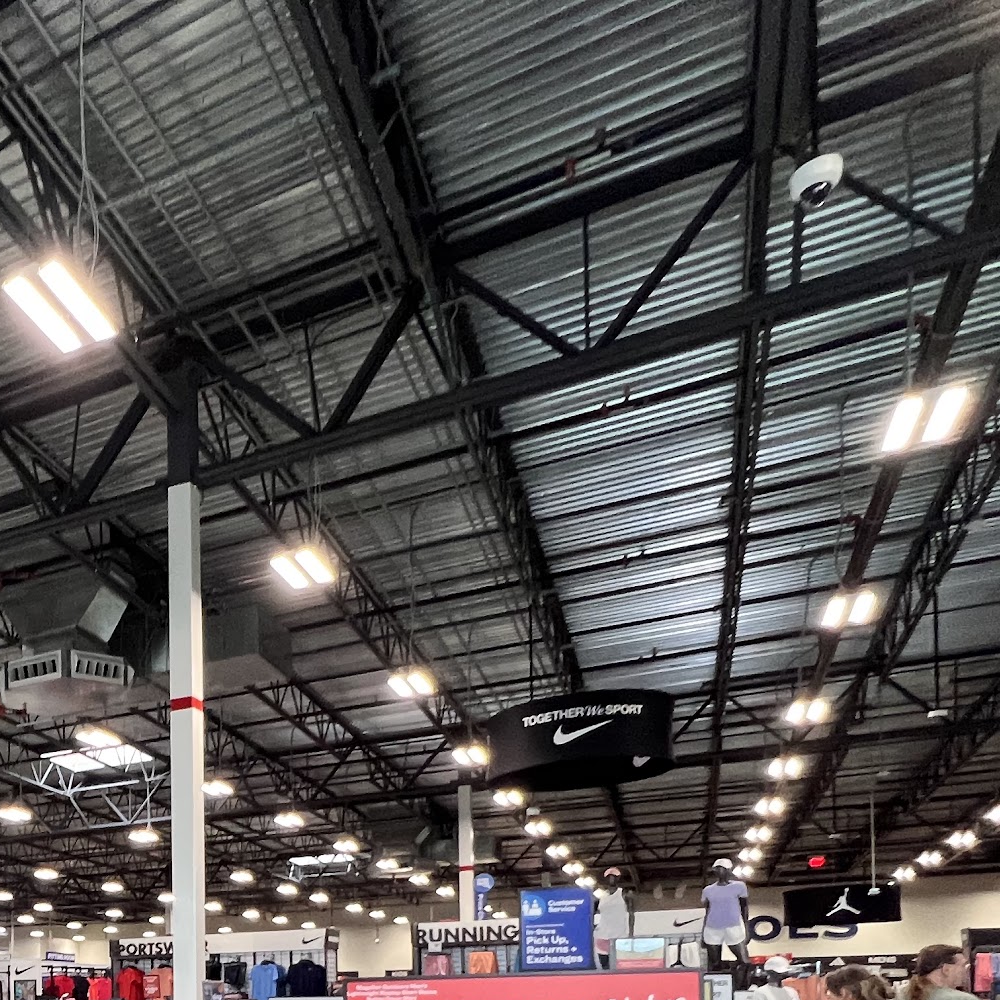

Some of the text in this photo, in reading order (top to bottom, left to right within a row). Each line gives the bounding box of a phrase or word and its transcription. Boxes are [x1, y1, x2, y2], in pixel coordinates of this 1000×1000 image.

[522, 706, 584, 728] TOGETHER
[605, 704, 643, 715] SPORT
[418, 925, 519, 945] RUNNING
[526, 936, 549, 945] Pick
[526, 944, 569, 954] Returns
[526, 953, 583, 964] Exchanges
